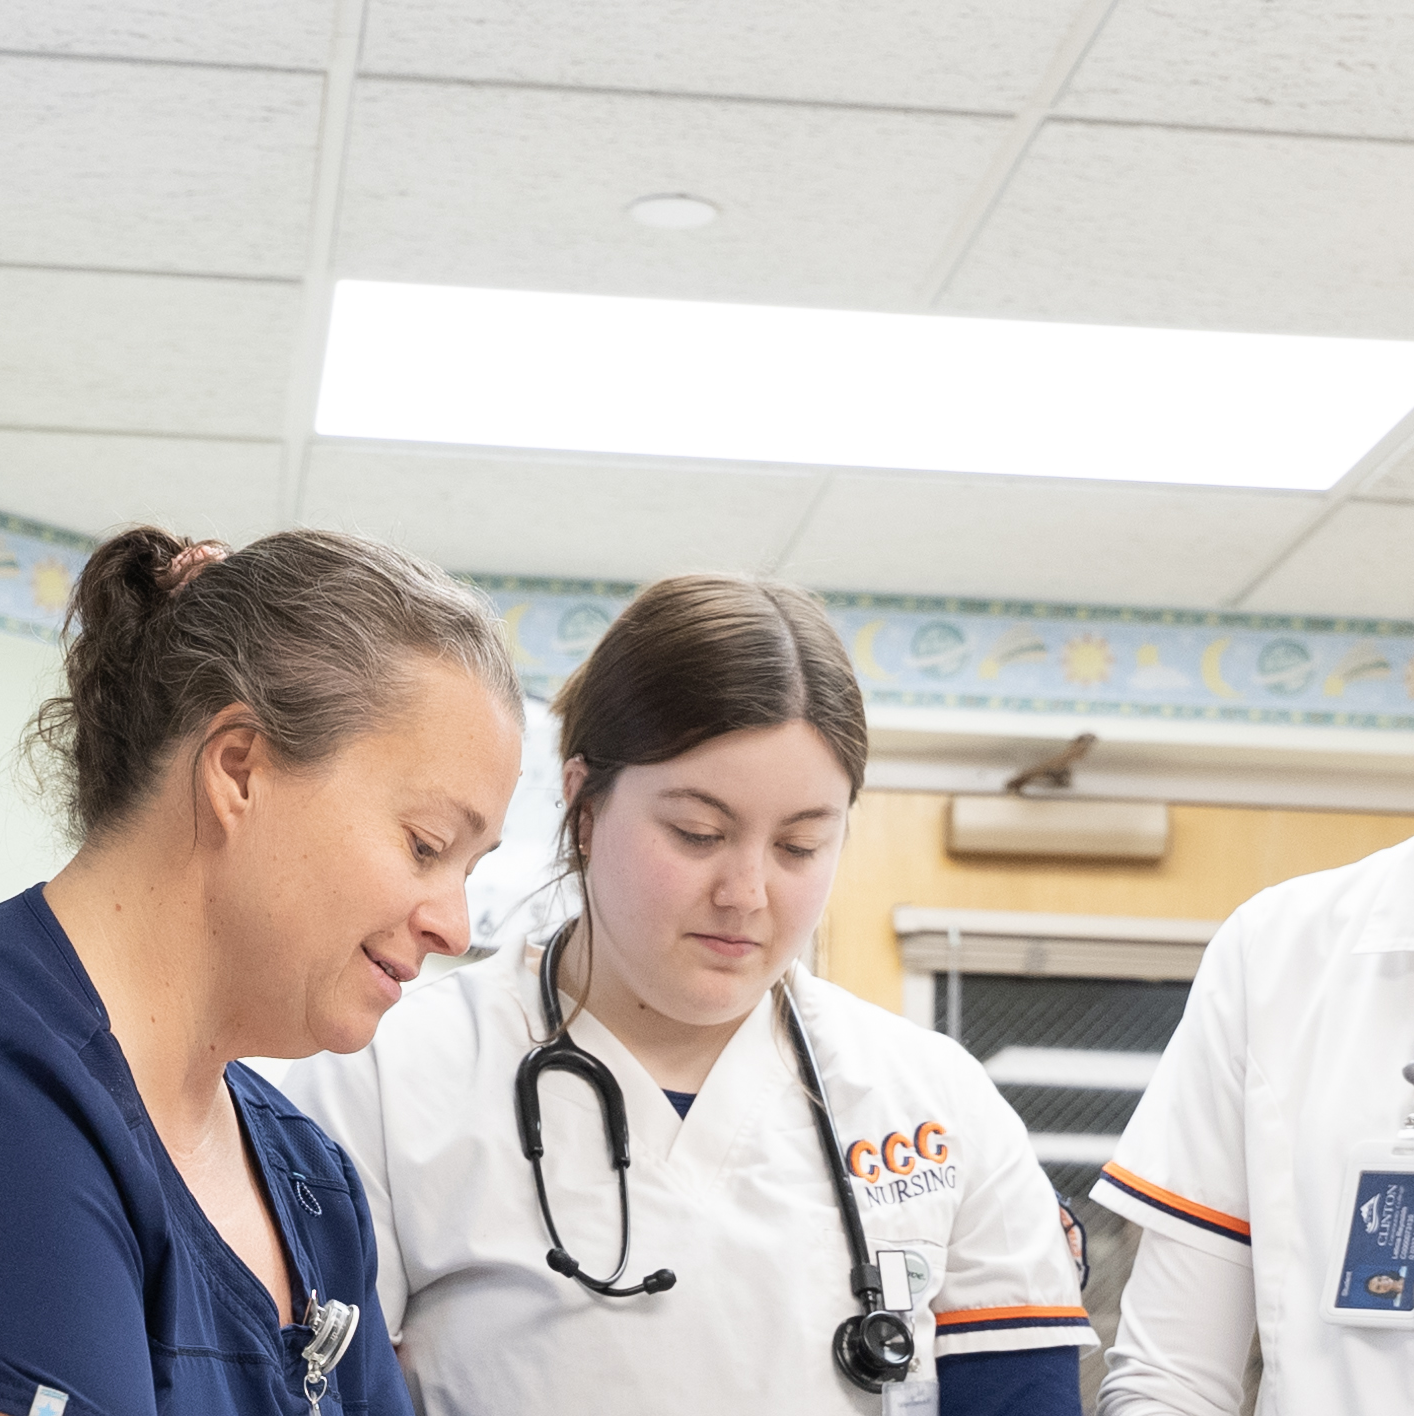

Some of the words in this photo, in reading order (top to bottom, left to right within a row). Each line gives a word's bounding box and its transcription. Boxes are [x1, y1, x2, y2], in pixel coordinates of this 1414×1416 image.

[845, 1121, 948, 1184] CCC
[865, 1165, 956, 1208] NURSING
[1377, 1184, 1398, 1246] CLINTON
